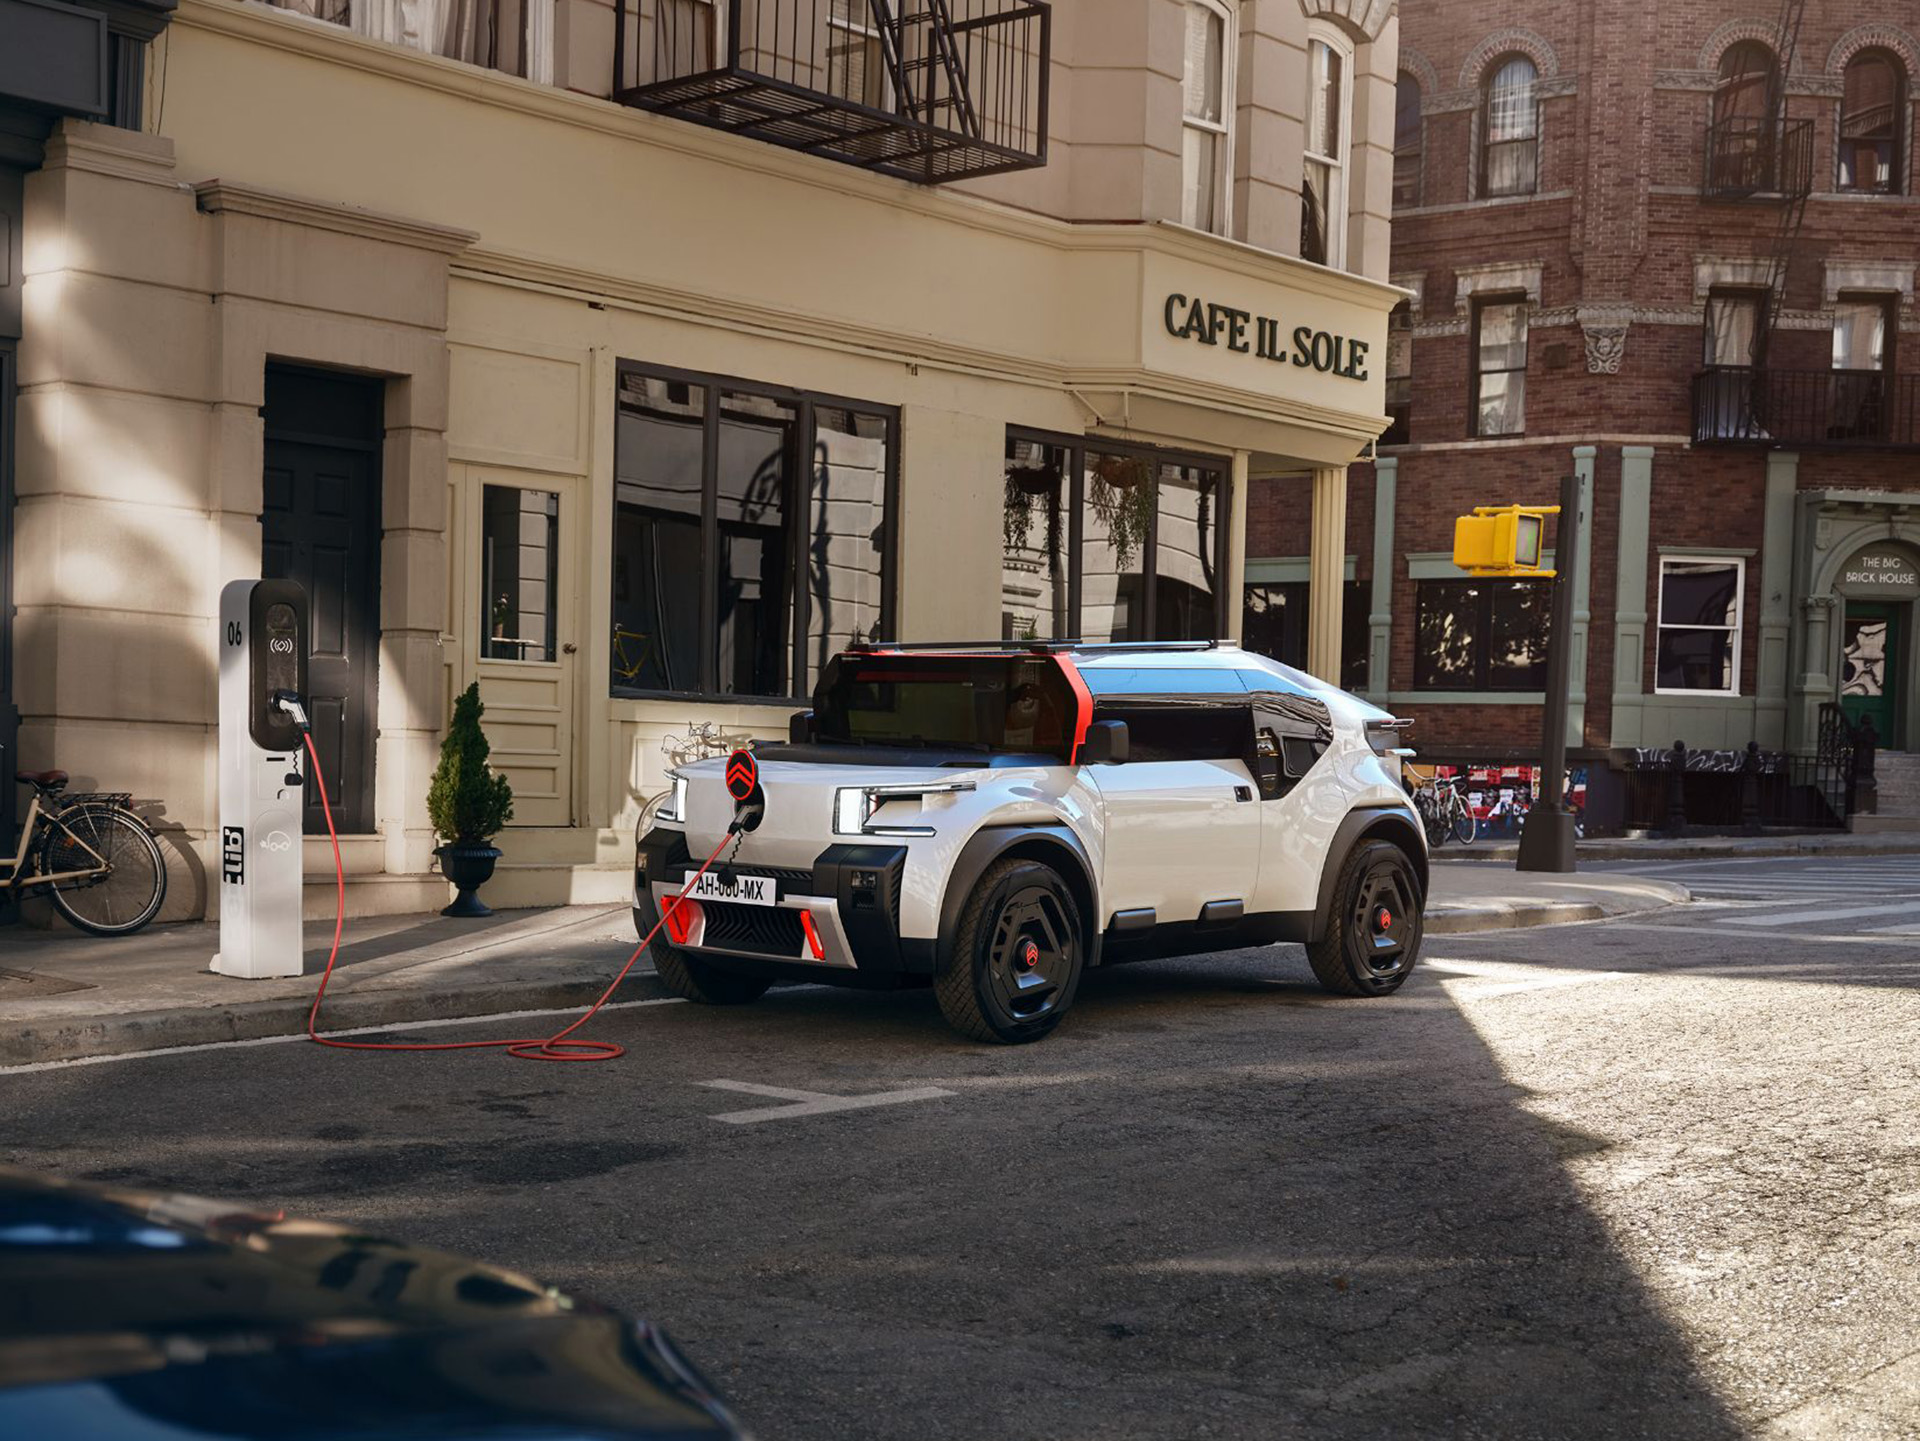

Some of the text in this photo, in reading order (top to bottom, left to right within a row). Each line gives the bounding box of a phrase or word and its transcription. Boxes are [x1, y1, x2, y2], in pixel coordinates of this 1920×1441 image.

[1164, 293, 1369, 381] CAFE IL SOLE
[1862, 556, 1901, 569] THE BIG
[1845, 571, 1915, 584] BRICK HOUSE
[227, 621, 242, 646] 06
